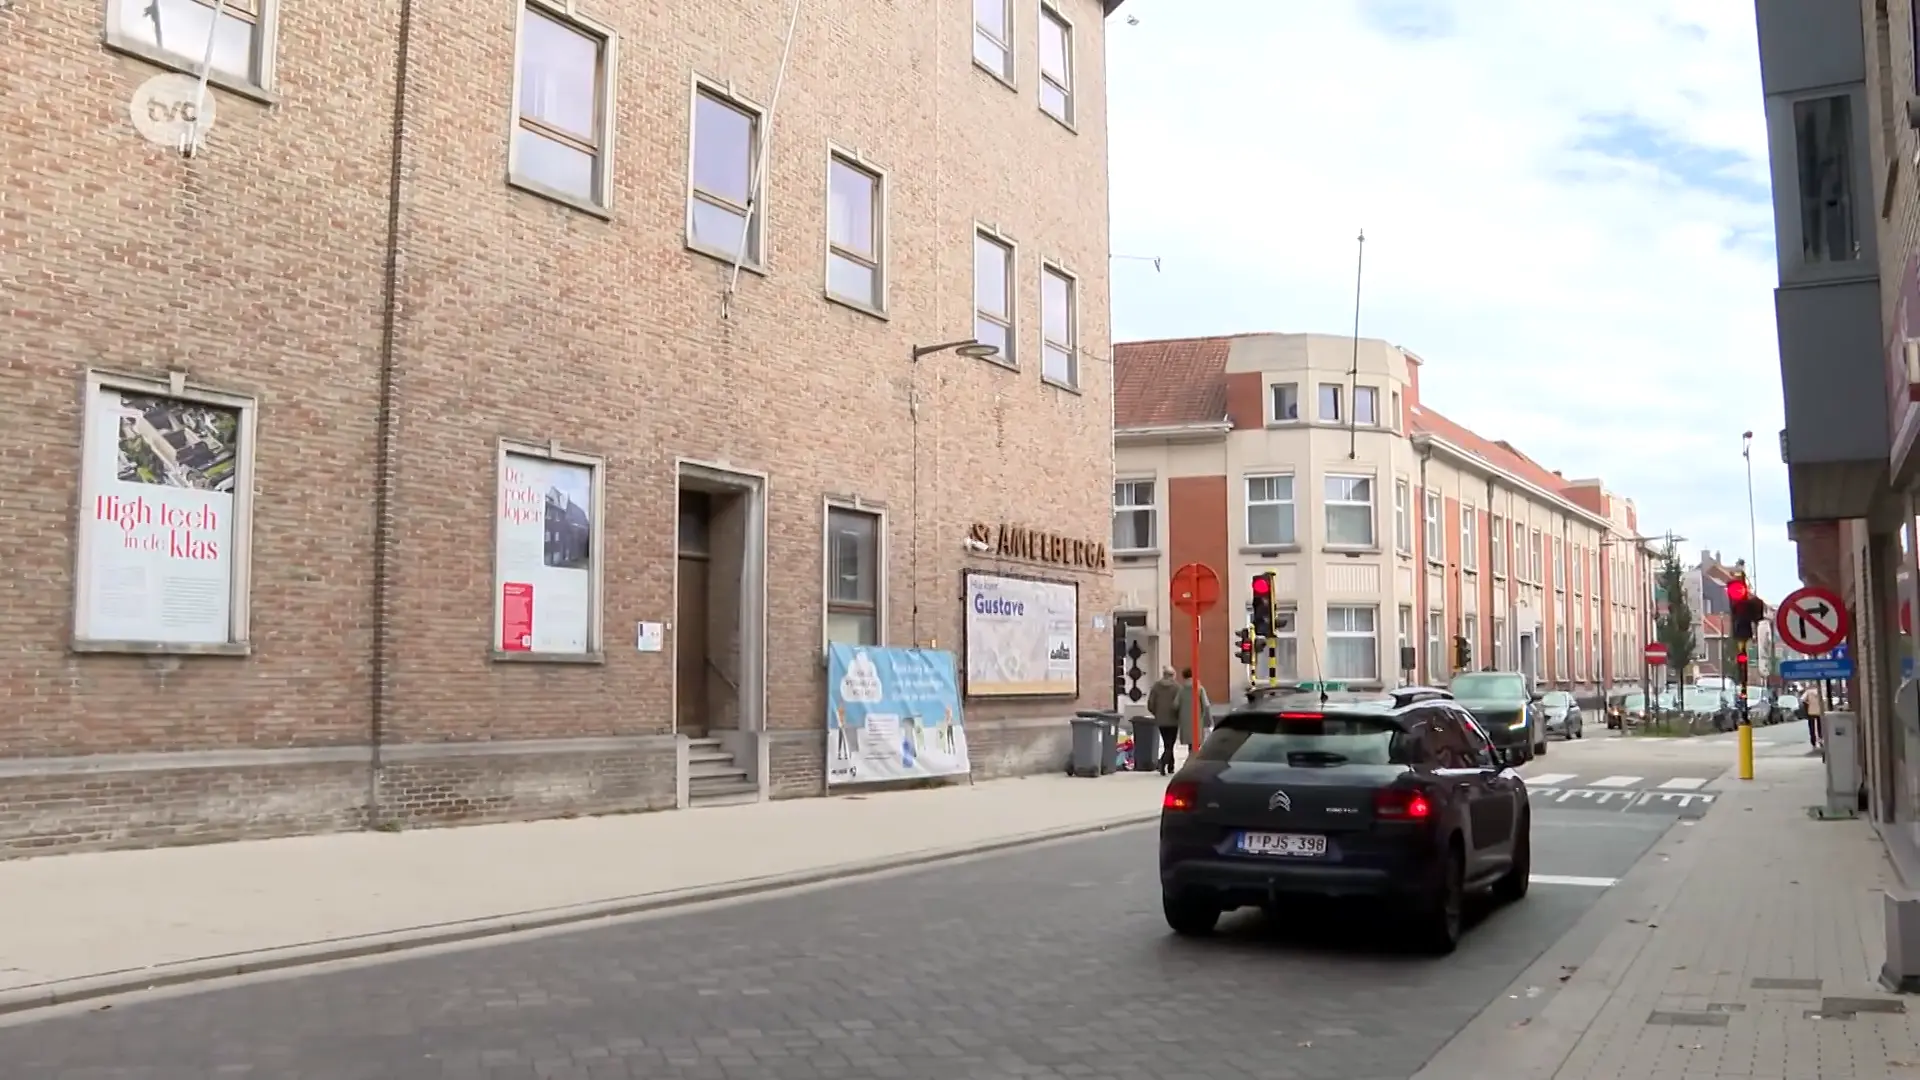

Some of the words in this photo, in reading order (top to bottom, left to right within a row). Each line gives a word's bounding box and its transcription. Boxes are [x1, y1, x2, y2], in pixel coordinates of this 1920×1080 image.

[96, 495, 151, 531] High
[161, 503, 217, 530] tech
[124, 533, 138, 549] in
[143, 533, 165, 551] de
[170, 530, 218, 560] klas
[997, 523, 1106, 569] AMELBERGA
[974, 593, 1024, 616] Gustave
